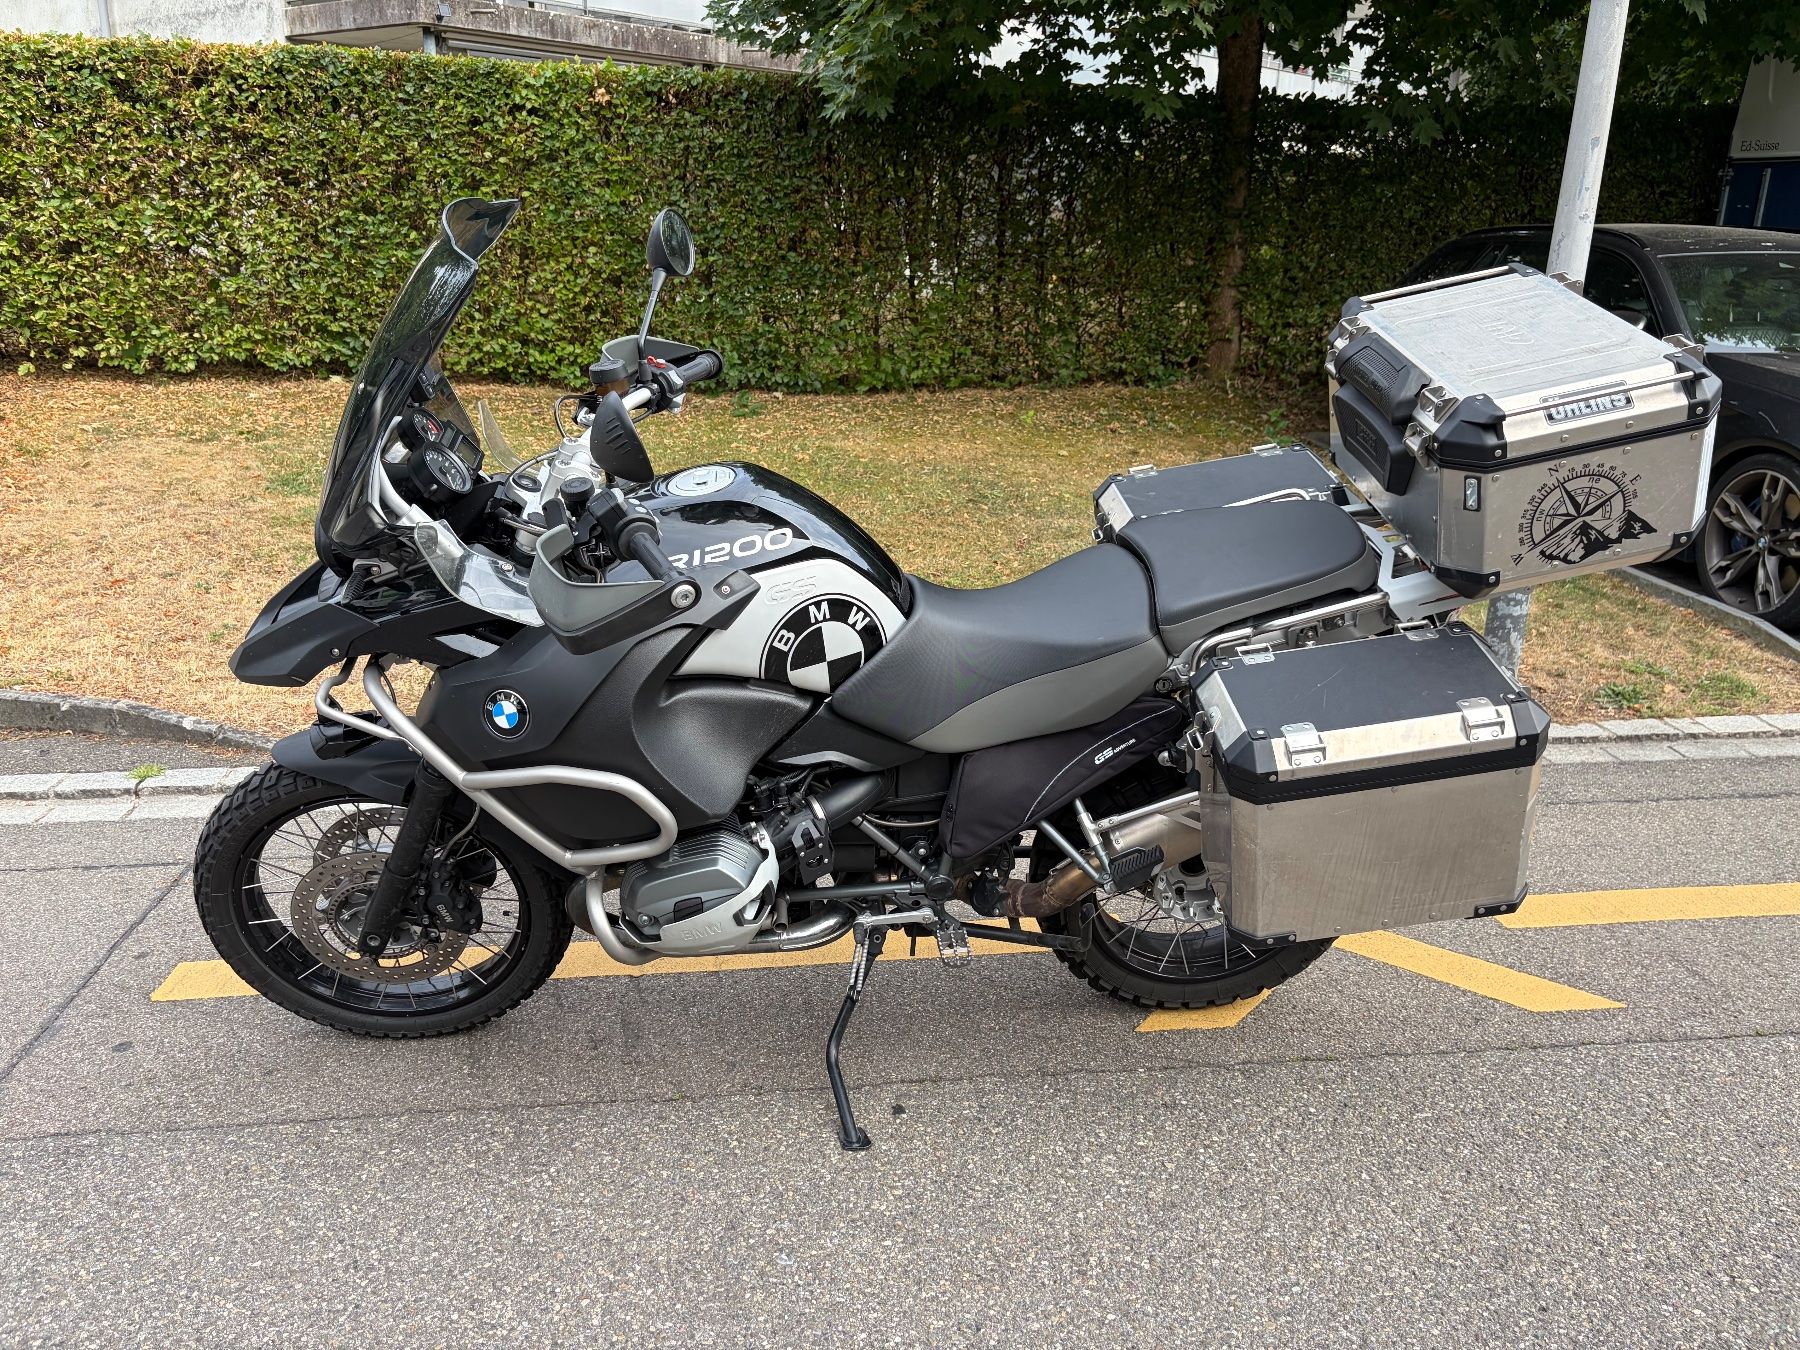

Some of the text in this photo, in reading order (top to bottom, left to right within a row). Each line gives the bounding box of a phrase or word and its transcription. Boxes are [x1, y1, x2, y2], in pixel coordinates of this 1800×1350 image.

[1547, 463, 1560, 477] N
[1629, 473, 1642, 486] E
[667, 527, 793, 569] R1200
[772, 600, 871, 653] BMW
[486, 692, 520, 711] BMW
[1094, 746, 1114, 765] GS
[679, 921, 722, 941] BMW
